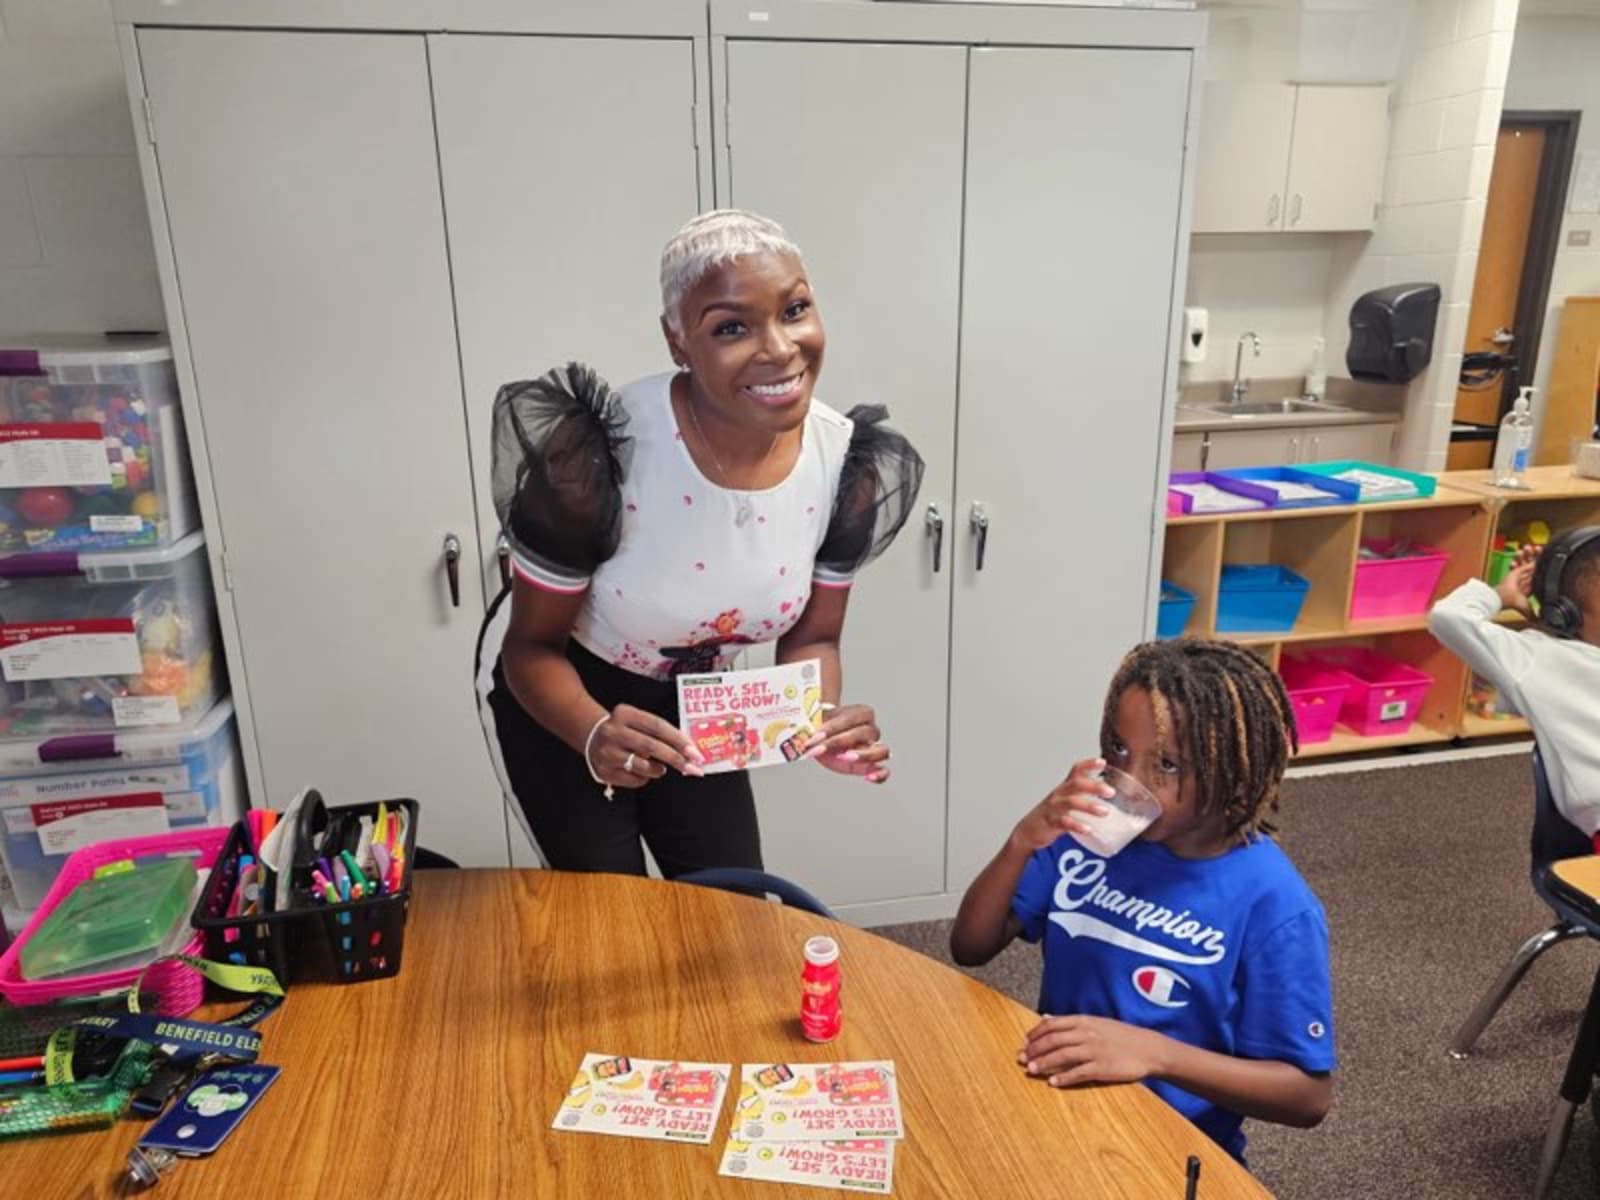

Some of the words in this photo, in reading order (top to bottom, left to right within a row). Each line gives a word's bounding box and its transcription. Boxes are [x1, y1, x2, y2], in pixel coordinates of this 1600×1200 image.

[685, 698, 725, 713] LET'S
[730, 694, 781, 709] GROW!
[1053, 848, 1225, 951] Champion
[154, 1021, 234, 1048] BENEFIELD
[611, 1103, 668, 1118] GROW!
[671, 1109, 713, 1121] LET'S
[792, 1108, 848, 1119] GROW!
[853, 1107, 895, 1119] LET'S
[778, 1147, 838, 1163] GROW!
[843, 1154, 887, 1169] LET'S
